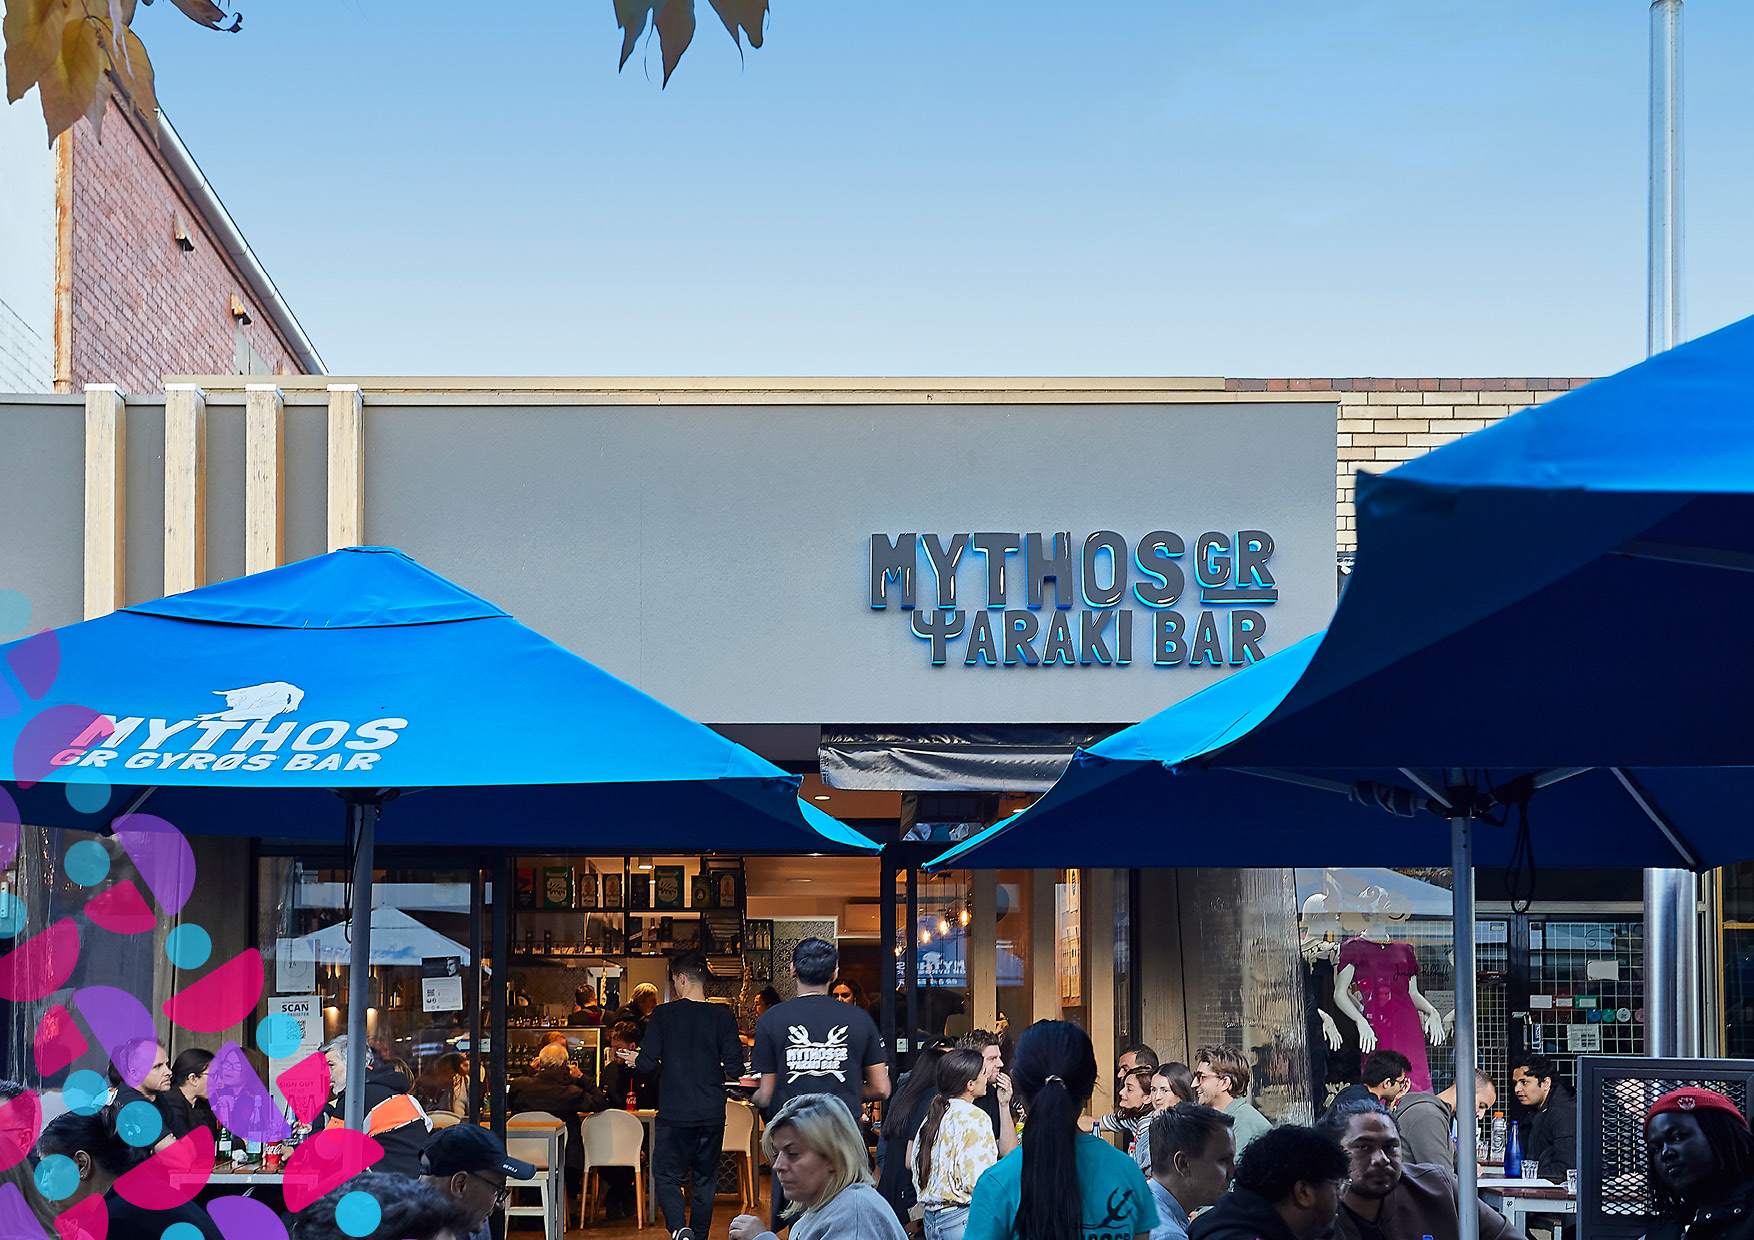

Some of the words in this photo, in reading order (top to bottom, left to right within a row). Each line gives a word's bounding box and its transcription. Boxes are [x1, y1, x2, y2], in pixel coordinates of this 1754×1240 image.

[869, 530, 1186, 609] MYTHOS
[1152, 609, 1267, 666] BAR
[69, 714, 408, 751] MYTHOS
[49, 748, 119, 767] GR
[282, 753, 382, 771] BAR
[281, 1003, 309, 1013] SCAN
